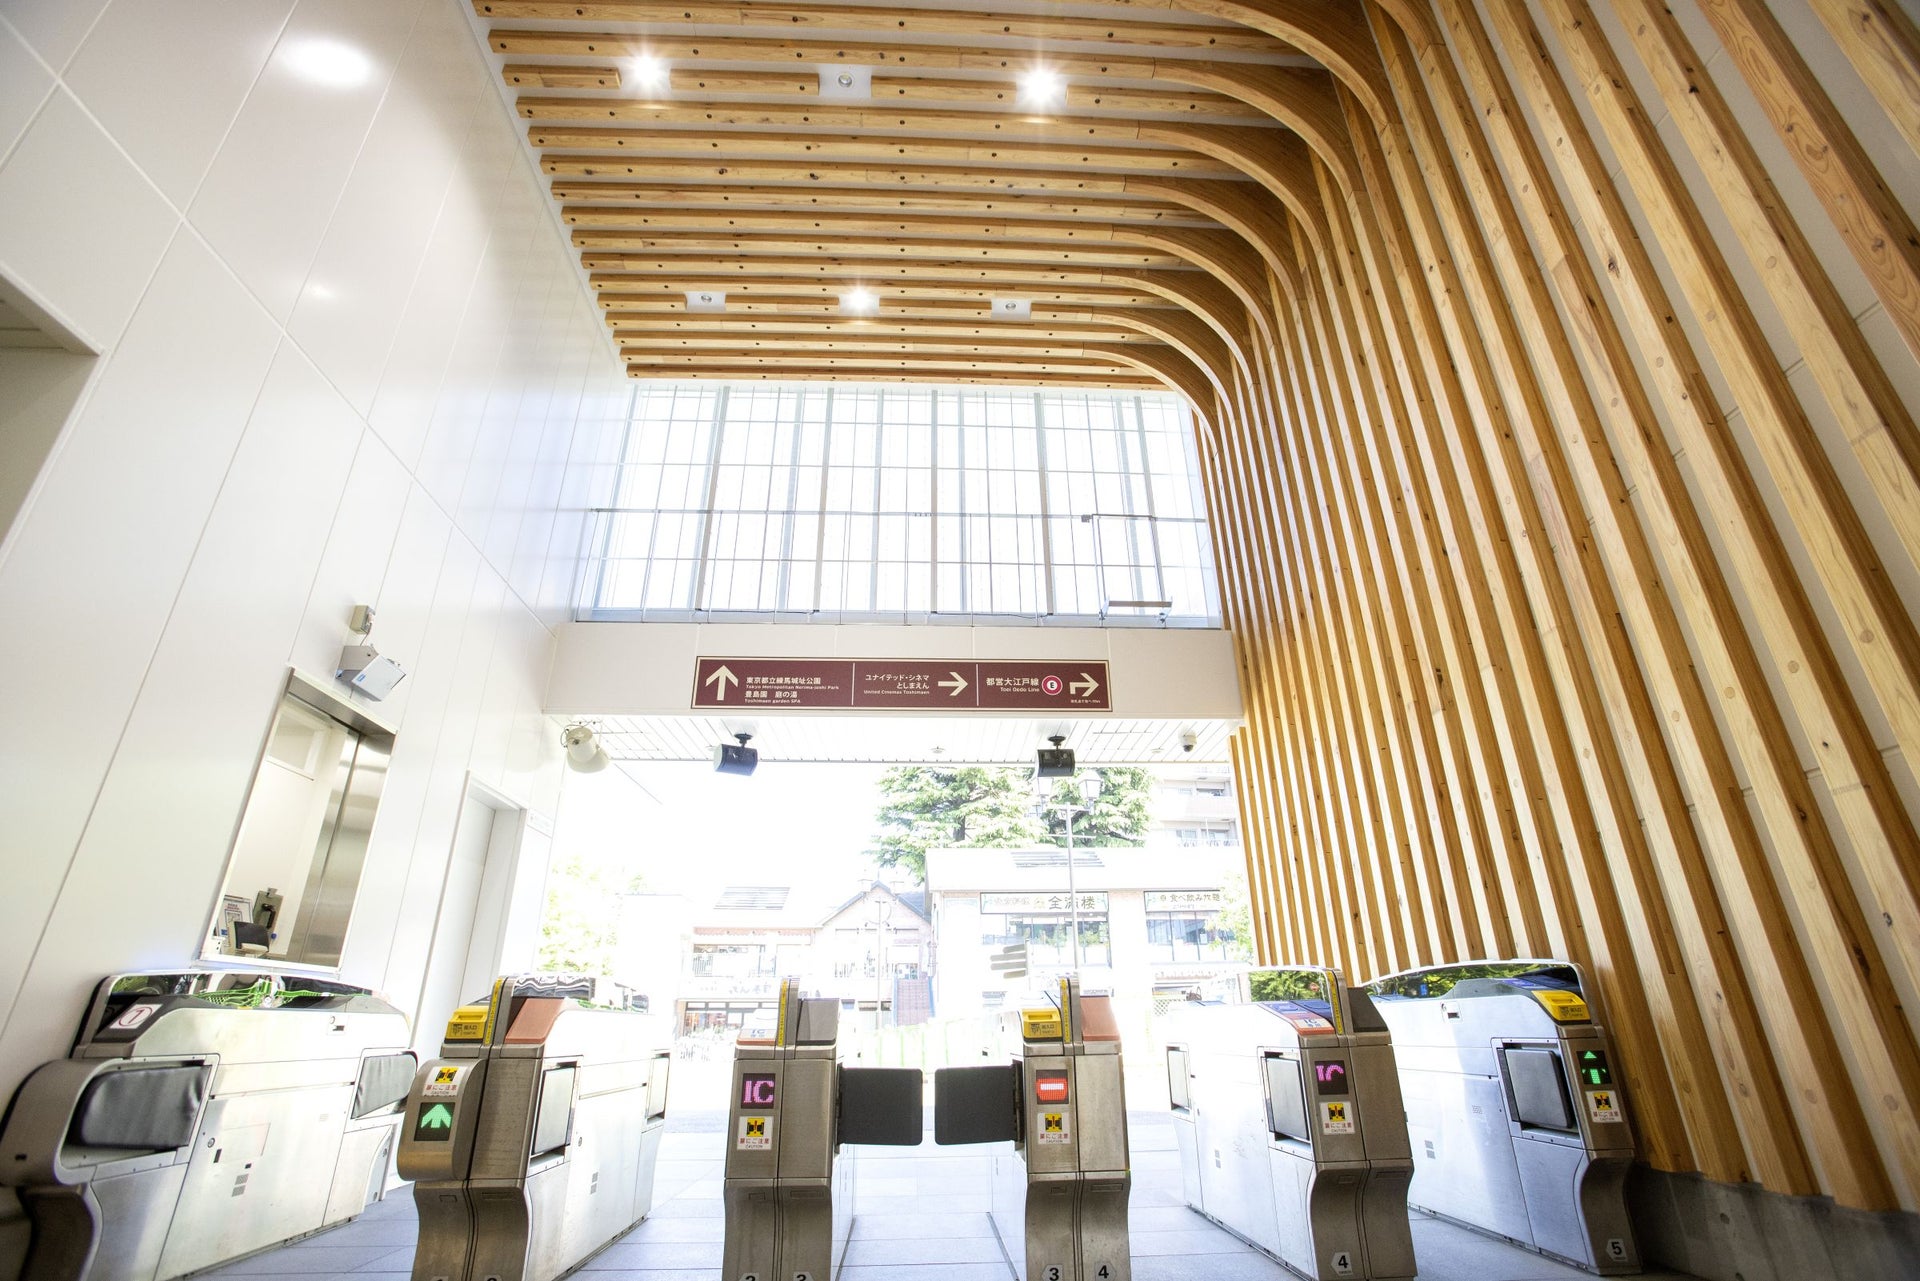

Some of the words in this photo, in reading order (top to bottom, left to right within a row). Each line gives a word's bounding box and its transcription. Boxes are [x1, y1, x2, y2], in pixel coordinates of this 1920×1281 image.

[986, 677, 1039, 686] 都営大江戸線
[744, 1081, 775, 1104] IC
[1611, 1241, 1622, 1255] 5
[1338, 1254, 1348, 1269] 4
[1049, 1267, 1059, 1281] 3
[1098, 1264, 1109, 1279] 4
